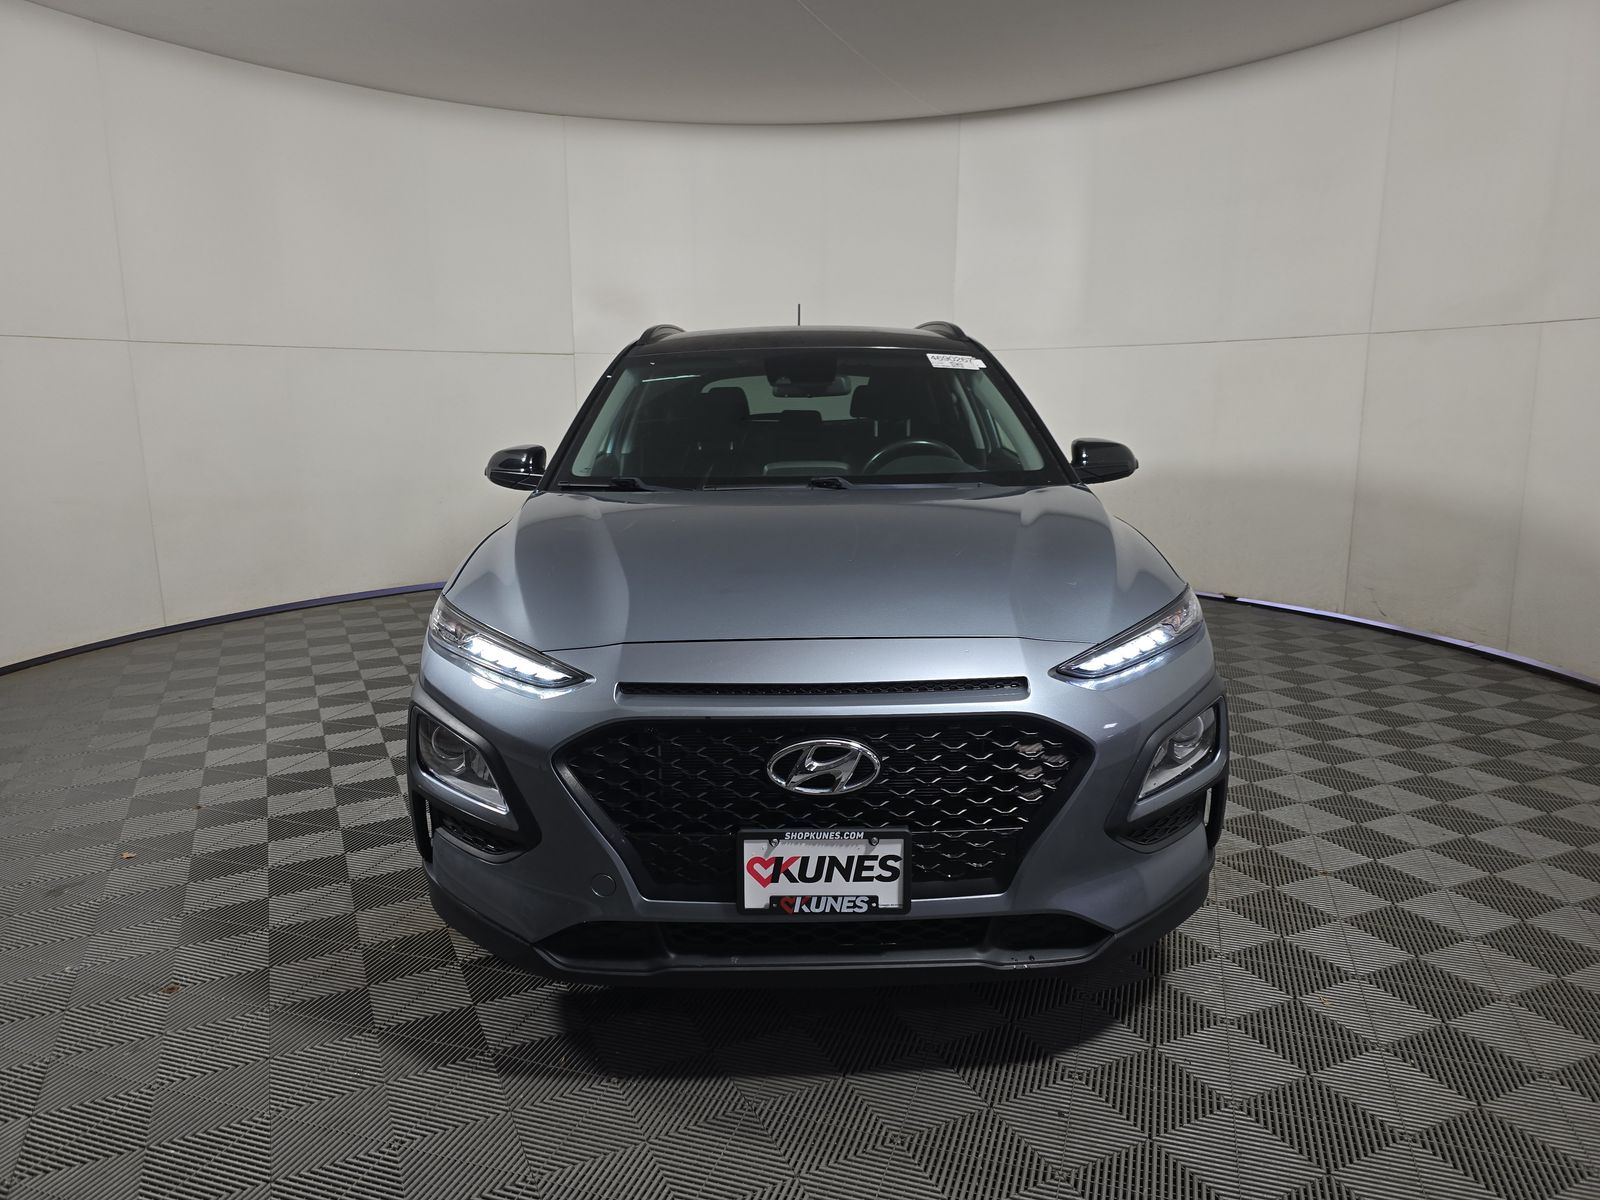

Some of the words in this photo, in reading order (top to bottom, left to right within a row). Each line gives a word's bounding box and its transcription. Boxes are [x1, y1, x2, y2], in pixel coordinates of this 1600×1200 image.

[784, 831, 864, 840] SHOPKUNES.COM
[770, 854, 903, 883] KUNES
[793, 896, 869, 913] KUNES
